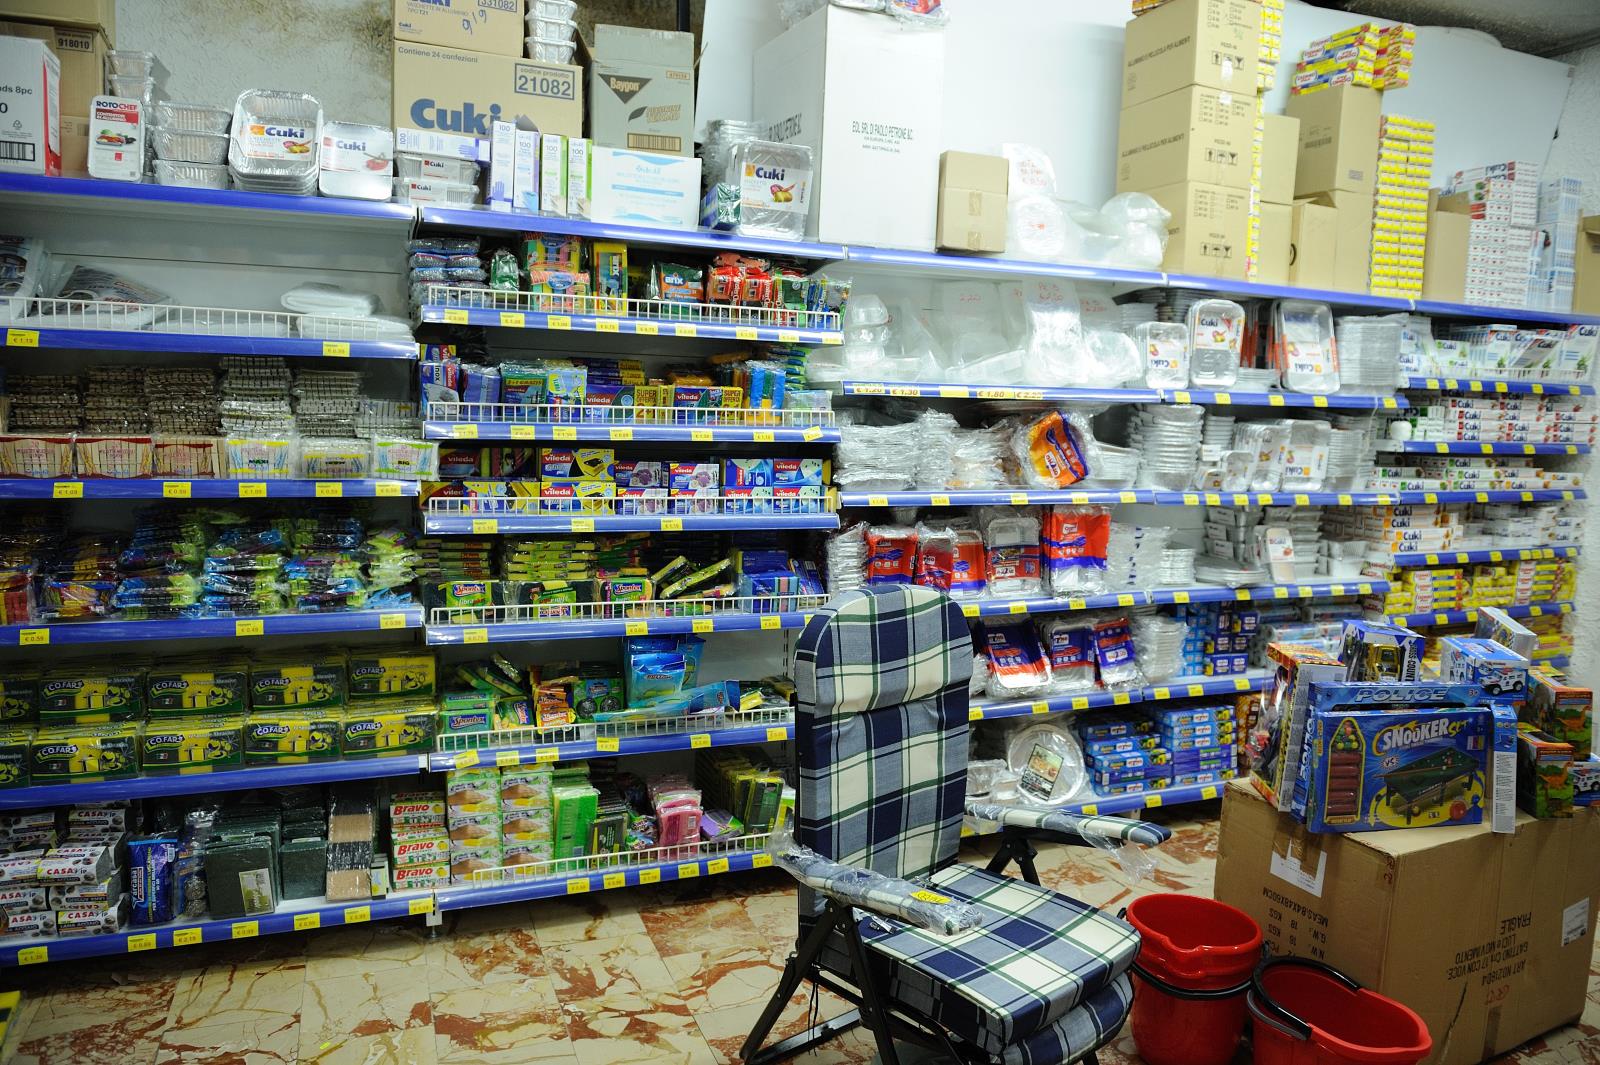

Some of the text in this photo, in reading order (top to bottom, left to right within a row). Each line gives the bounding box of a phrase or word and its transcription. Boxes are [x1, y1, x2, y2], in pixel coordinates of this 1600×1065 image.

[58, 39, 90, 50] 918010
[398, 46, 478, 63] Contiene 24 confezioni
[518, 75, 571, 96] 21082
[610, 77, 640, 92] Baygon
[15, 86, 33, 96] 8pc
[411, 98, 501, 135] Cuki
[265, 125, 305, 138] Cuki
[335, 139, 366, 152] Cuki
[519, 141, 531, 149] 100
[756, 166, 785, 181] Cuki
[1201, 318, 1218, 327] Cuki
[1579, 326, 1597, 336] Cuki
[1495, 333, 1510, 341] Cuki
[637, 389, 656, 397] SUPER
[724, 389, 741, 397] SUPER
[1458, 400, 1474, 408] Cuki
[1506, 402, 1521, 410] Cuki
[1465, 411, 1481, 420] Cuki
[1464, 422, 1481, 431] Cuki
[1514, 423, 1529, 431] Cuki
[1464, 432, 1479, 441] Cuki
[544, 454, 571, 462] vileda
[1455, 459, 1471, 467] Cuki
[1464, 470, 1480, 479] Cuki
[1504, 469, 1519, 478] Cuki
[1407, 481, 1424, 490] Cuki
[1459, 481, 1475, 489] Cuki
[1511, 480, 1527, 489] Cuki
[544, 488, 571, 496] vileda
[1394, 506, 1412, 516] Cuki
[1392, 517, 1410, 527] Cuki
[1403, 530, 1422, 540] Cuki
[1399, 541, 1417, 551] Cuki
[617, 584, 641, 592] Spontex
[1356, 688, 1448, 702] POLICE
[453, 717, 485, 728] Spontex
[1382, 718, 1449, 751] SNOOKER
[393, 804, 429, 816] Bravo
[397, 840, 434, 855] Bravo
[396, 867, 433, 880] Bravo
[68, 911, 96, 919] CASA
[1268, 907, 1282, 921] KGS
[1500, 912, 1532, 935] FRAGILE
[1268, 924, 1281, 938] KGS
